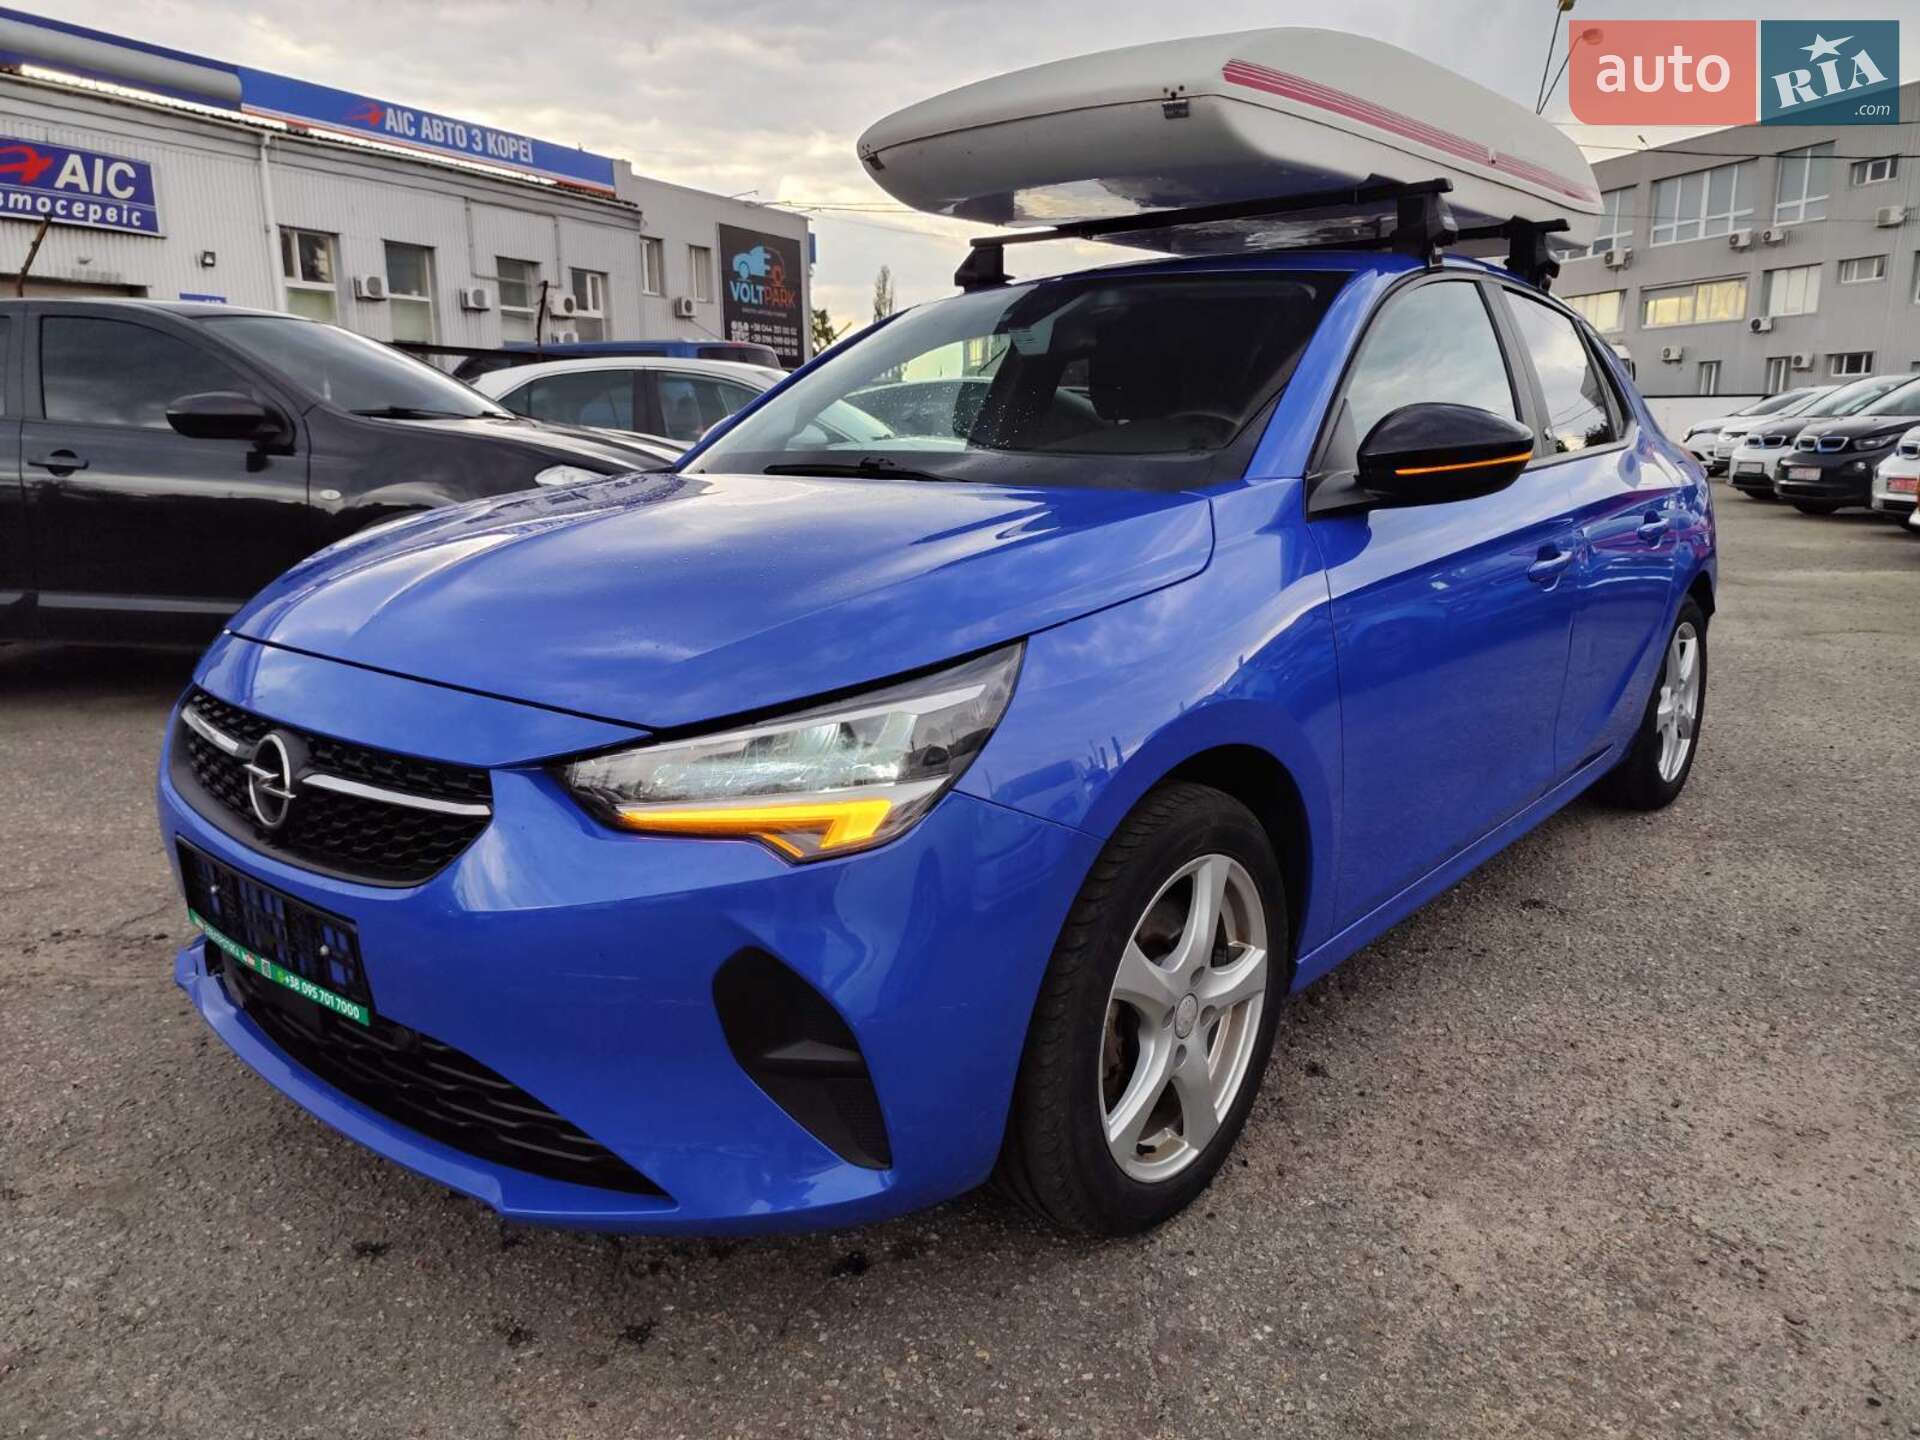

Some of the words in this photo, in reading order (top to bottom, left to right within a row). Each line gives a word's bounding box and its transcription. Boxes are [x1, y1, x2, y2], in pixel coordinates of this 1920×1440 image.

[421, 117, 467, 148] АВТО
[486, 132, 534, 164] КОРЕЇ
[285, 975, 300, 991] +38
[301, 981, 318, 999] 095
[319, 990, 335, 1008] 701
[335, 997, 360, 1019] 7000
